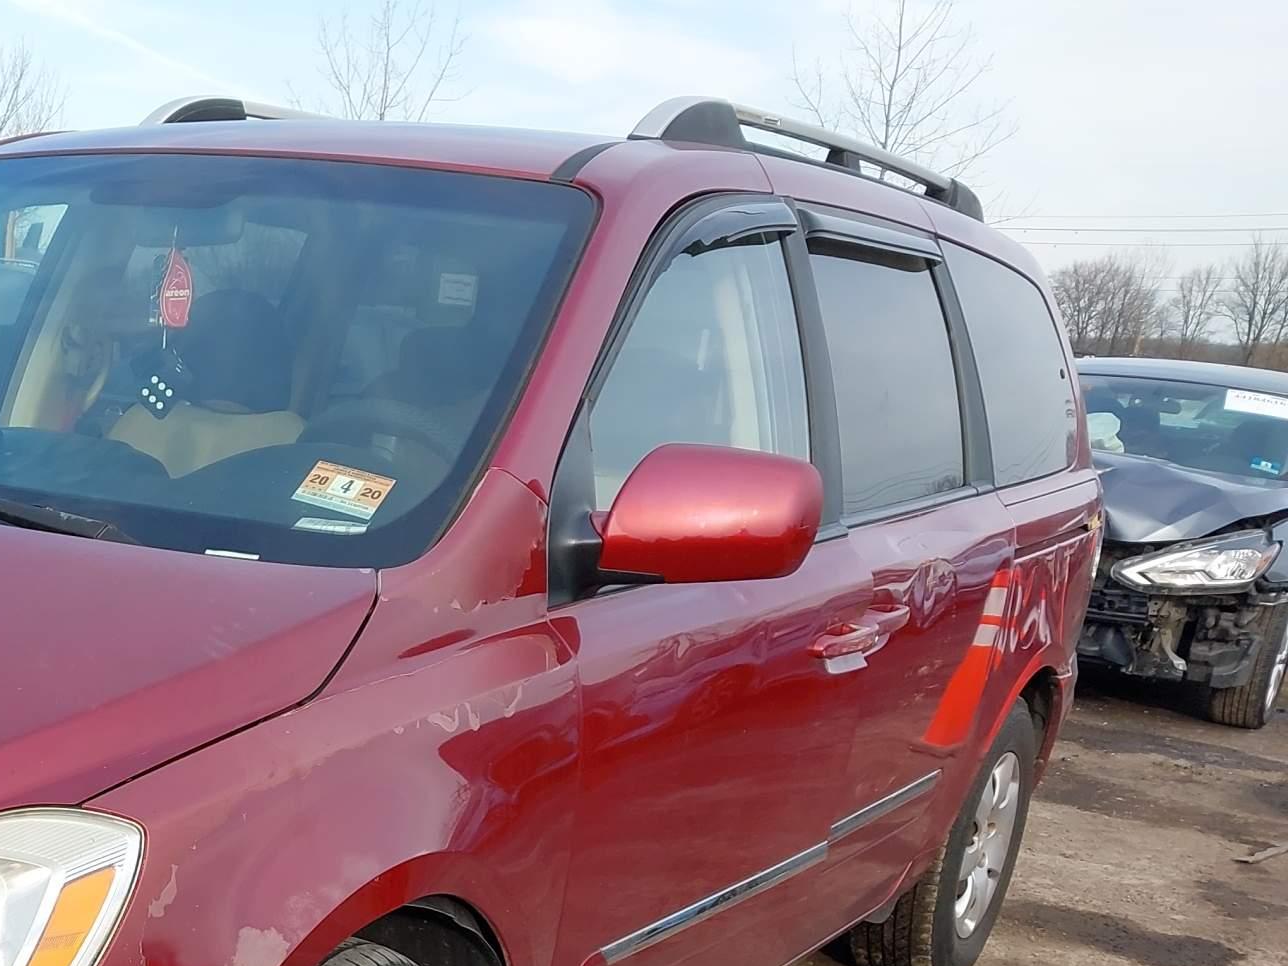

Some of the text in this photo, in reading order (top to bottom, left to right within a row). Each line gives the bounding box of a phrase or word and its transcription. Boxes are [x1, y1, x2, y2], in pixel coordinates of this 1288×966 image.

[165, 289, 190, 297] areon
[309, 473, 330, 486] 20
[341, 480, 353, 494] 4
[360, 487, 382, 500] 20
